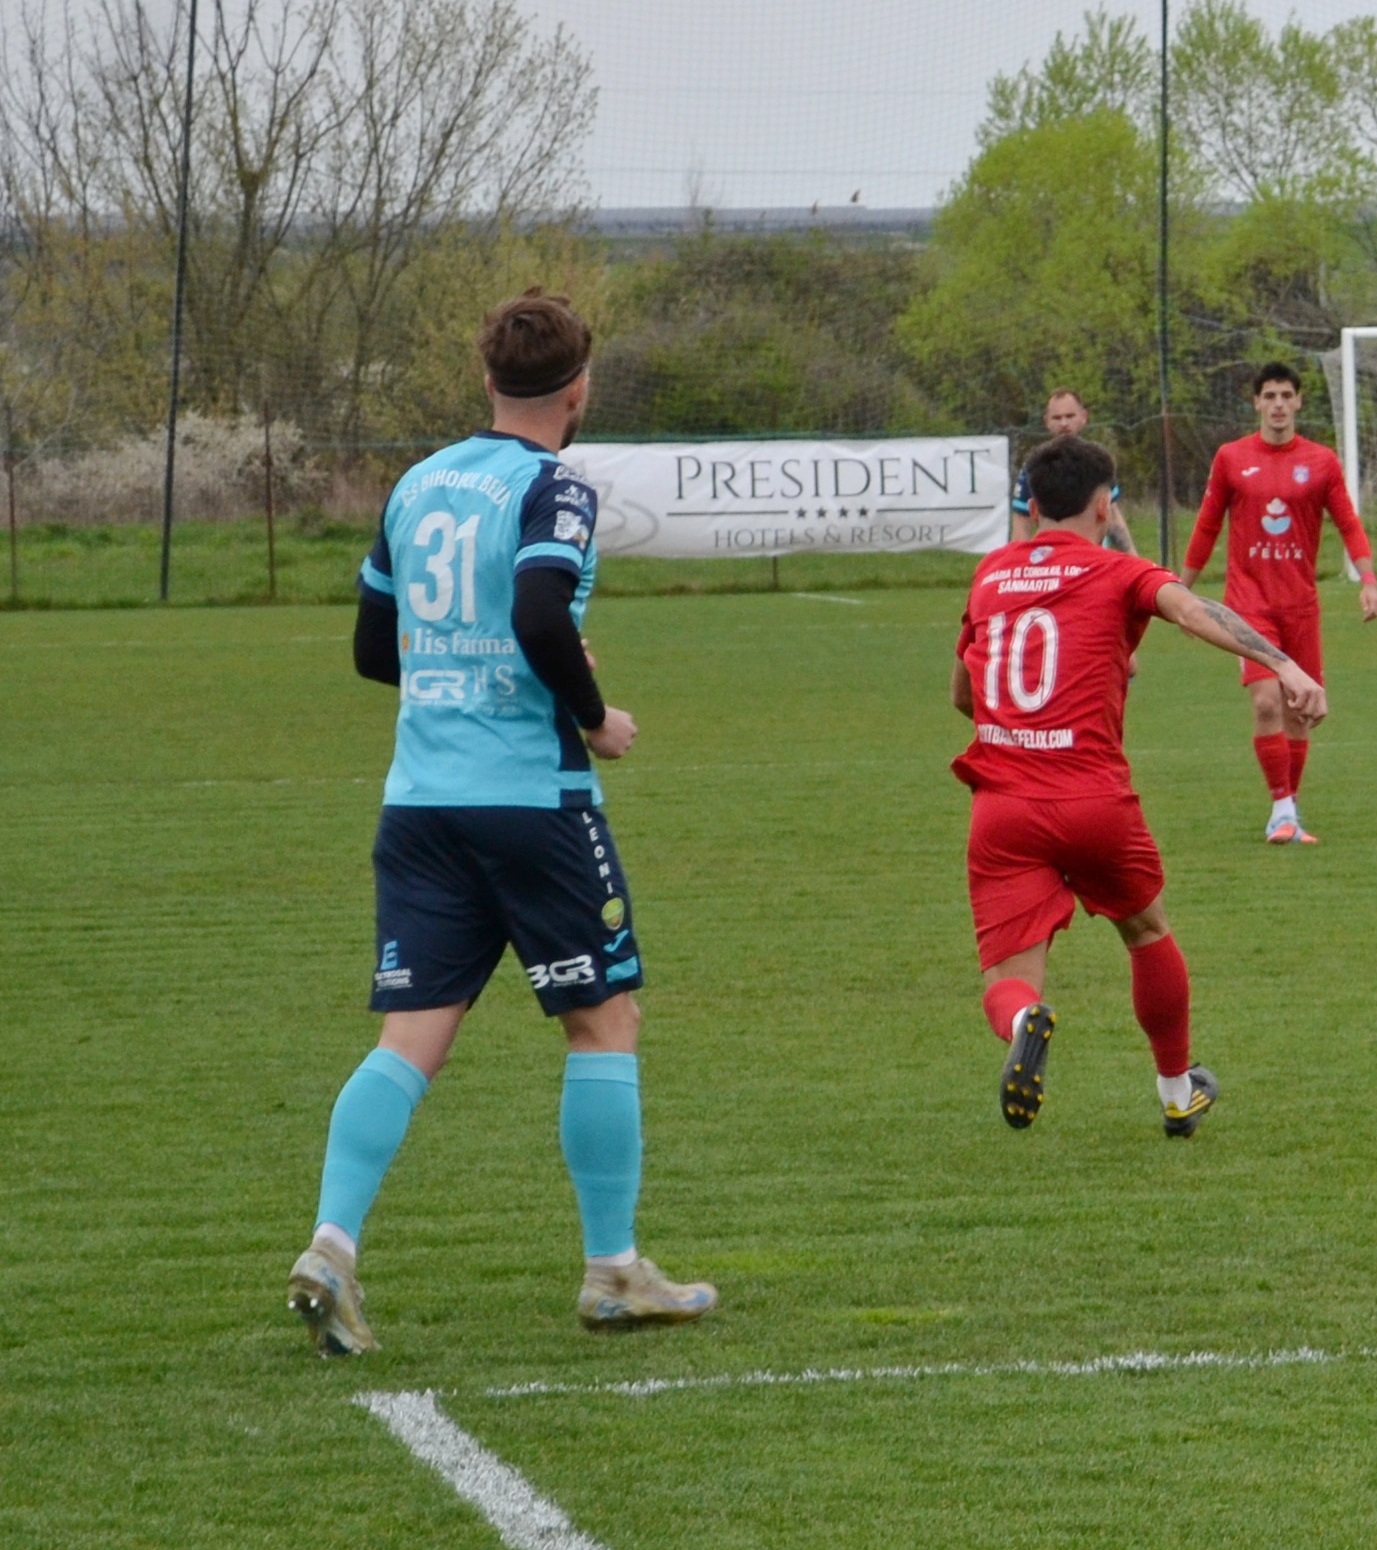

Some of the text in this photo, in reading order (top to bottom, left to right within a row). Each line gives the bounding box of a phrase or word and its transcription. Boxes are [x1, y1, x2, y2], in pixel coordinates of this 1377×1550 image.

[675, 449, 990, 500] PRESIDENT
[408, 511, 480, 623] 31
[714, 524, 951, 549] HOTELS & RESORT
[1249, 546, 1303, 560] FELIX
[984, 607, 1059, 713] 10
[582, 811, 613, 894] LEONI
